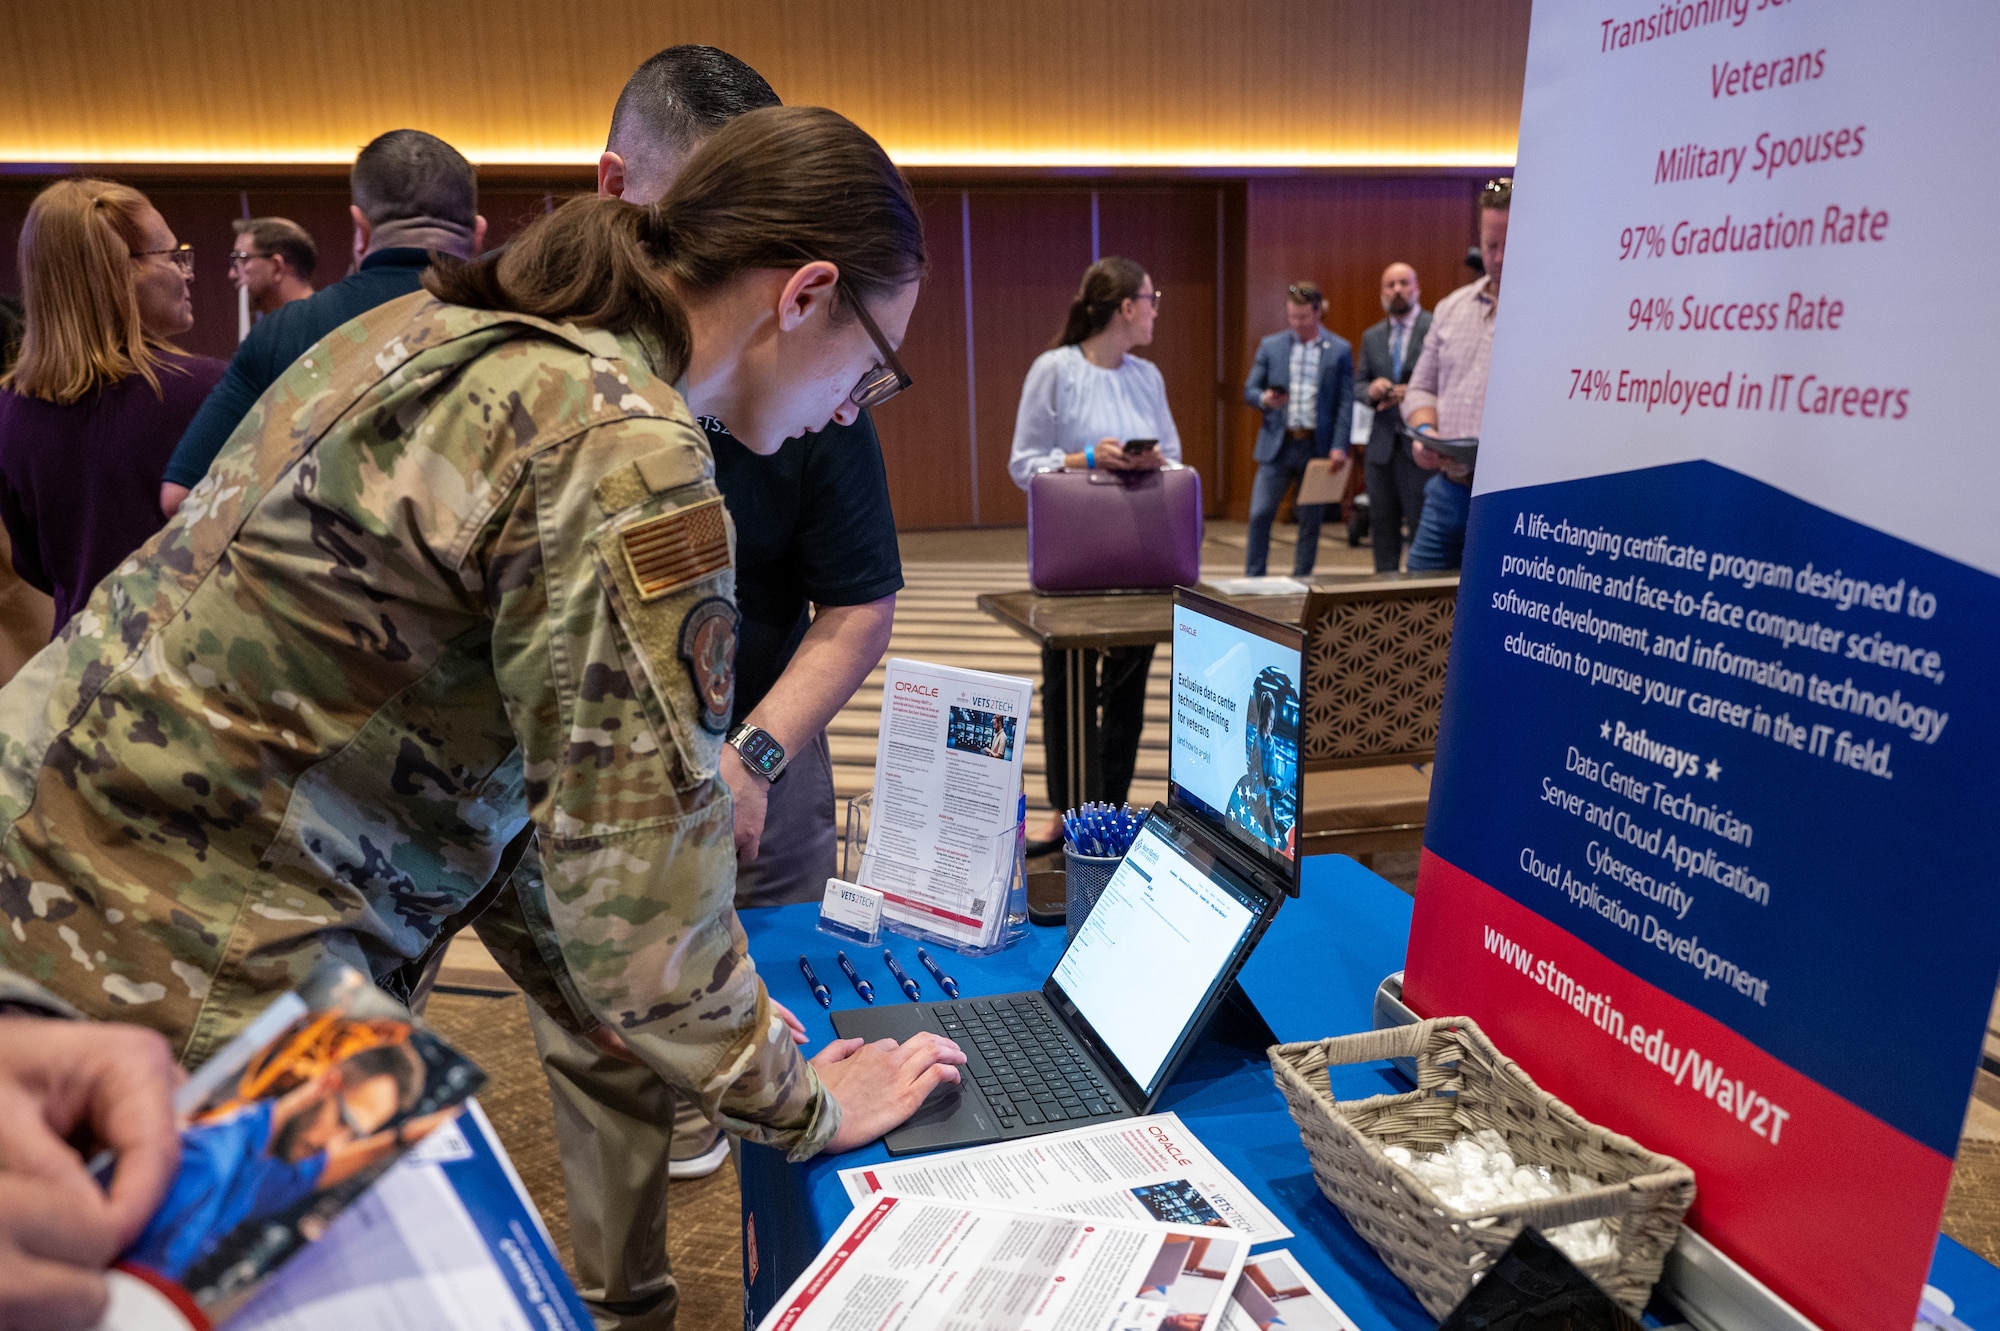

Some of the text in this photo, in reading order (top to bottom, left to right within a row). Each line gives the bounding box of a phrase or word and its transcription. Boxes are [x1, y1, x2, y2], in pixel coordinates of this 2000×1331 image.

[1600, 0, 1749, 53] Transitioning
[1710, 48, 1826, 99] Veterans
[1654, 124, 1866, 185] Military Spouses
[1619, 204, 1888, 261] 97% Graduation Rate
[1627, 292, 1844, 331] 94% Success Rate
[1568, 369, 1909, 420] 74% Employed in IT Careers
[1514, 512, 1937, 620] A life-changing certificate program designed to
[1179, 623, 1197, 637] ORACLE
[1501, 554, 1945, 684] provide online and face-to-face computer science,
[895, 681, 939, 698] ORACLE
[1178, 672, 1237, 713] Exclusive data center
[1491, 589, 1949, 745] software development, and information technology
[972, 696, 1013, 712] VETS2TECH
[1177, 710, 1209, 739] for veterans
[1178, 693, 1230, 733] technician training
[1504, 631, 1894, 779] education to pursue your career in the IT field.
[1614, 720, 1700, 782] Pathways
[1565, 746, 1753, 848] Data Center Technician
[1540, 776, 1771, 908] Server and Cloud Application
[841, 890, 875, 909] VETS2TECH
[1585, 839, 1694, 921] Cybersecurity
[1519, 846, 1770, 1008] Cloud Application Development
[1483, 924, 1791, 1146] www.stmartin.edu/WaV2T
[1148, 1125, 1192, 1167] ORACLE
[1210, 1193, 1255, 1234] VETS2TECH
